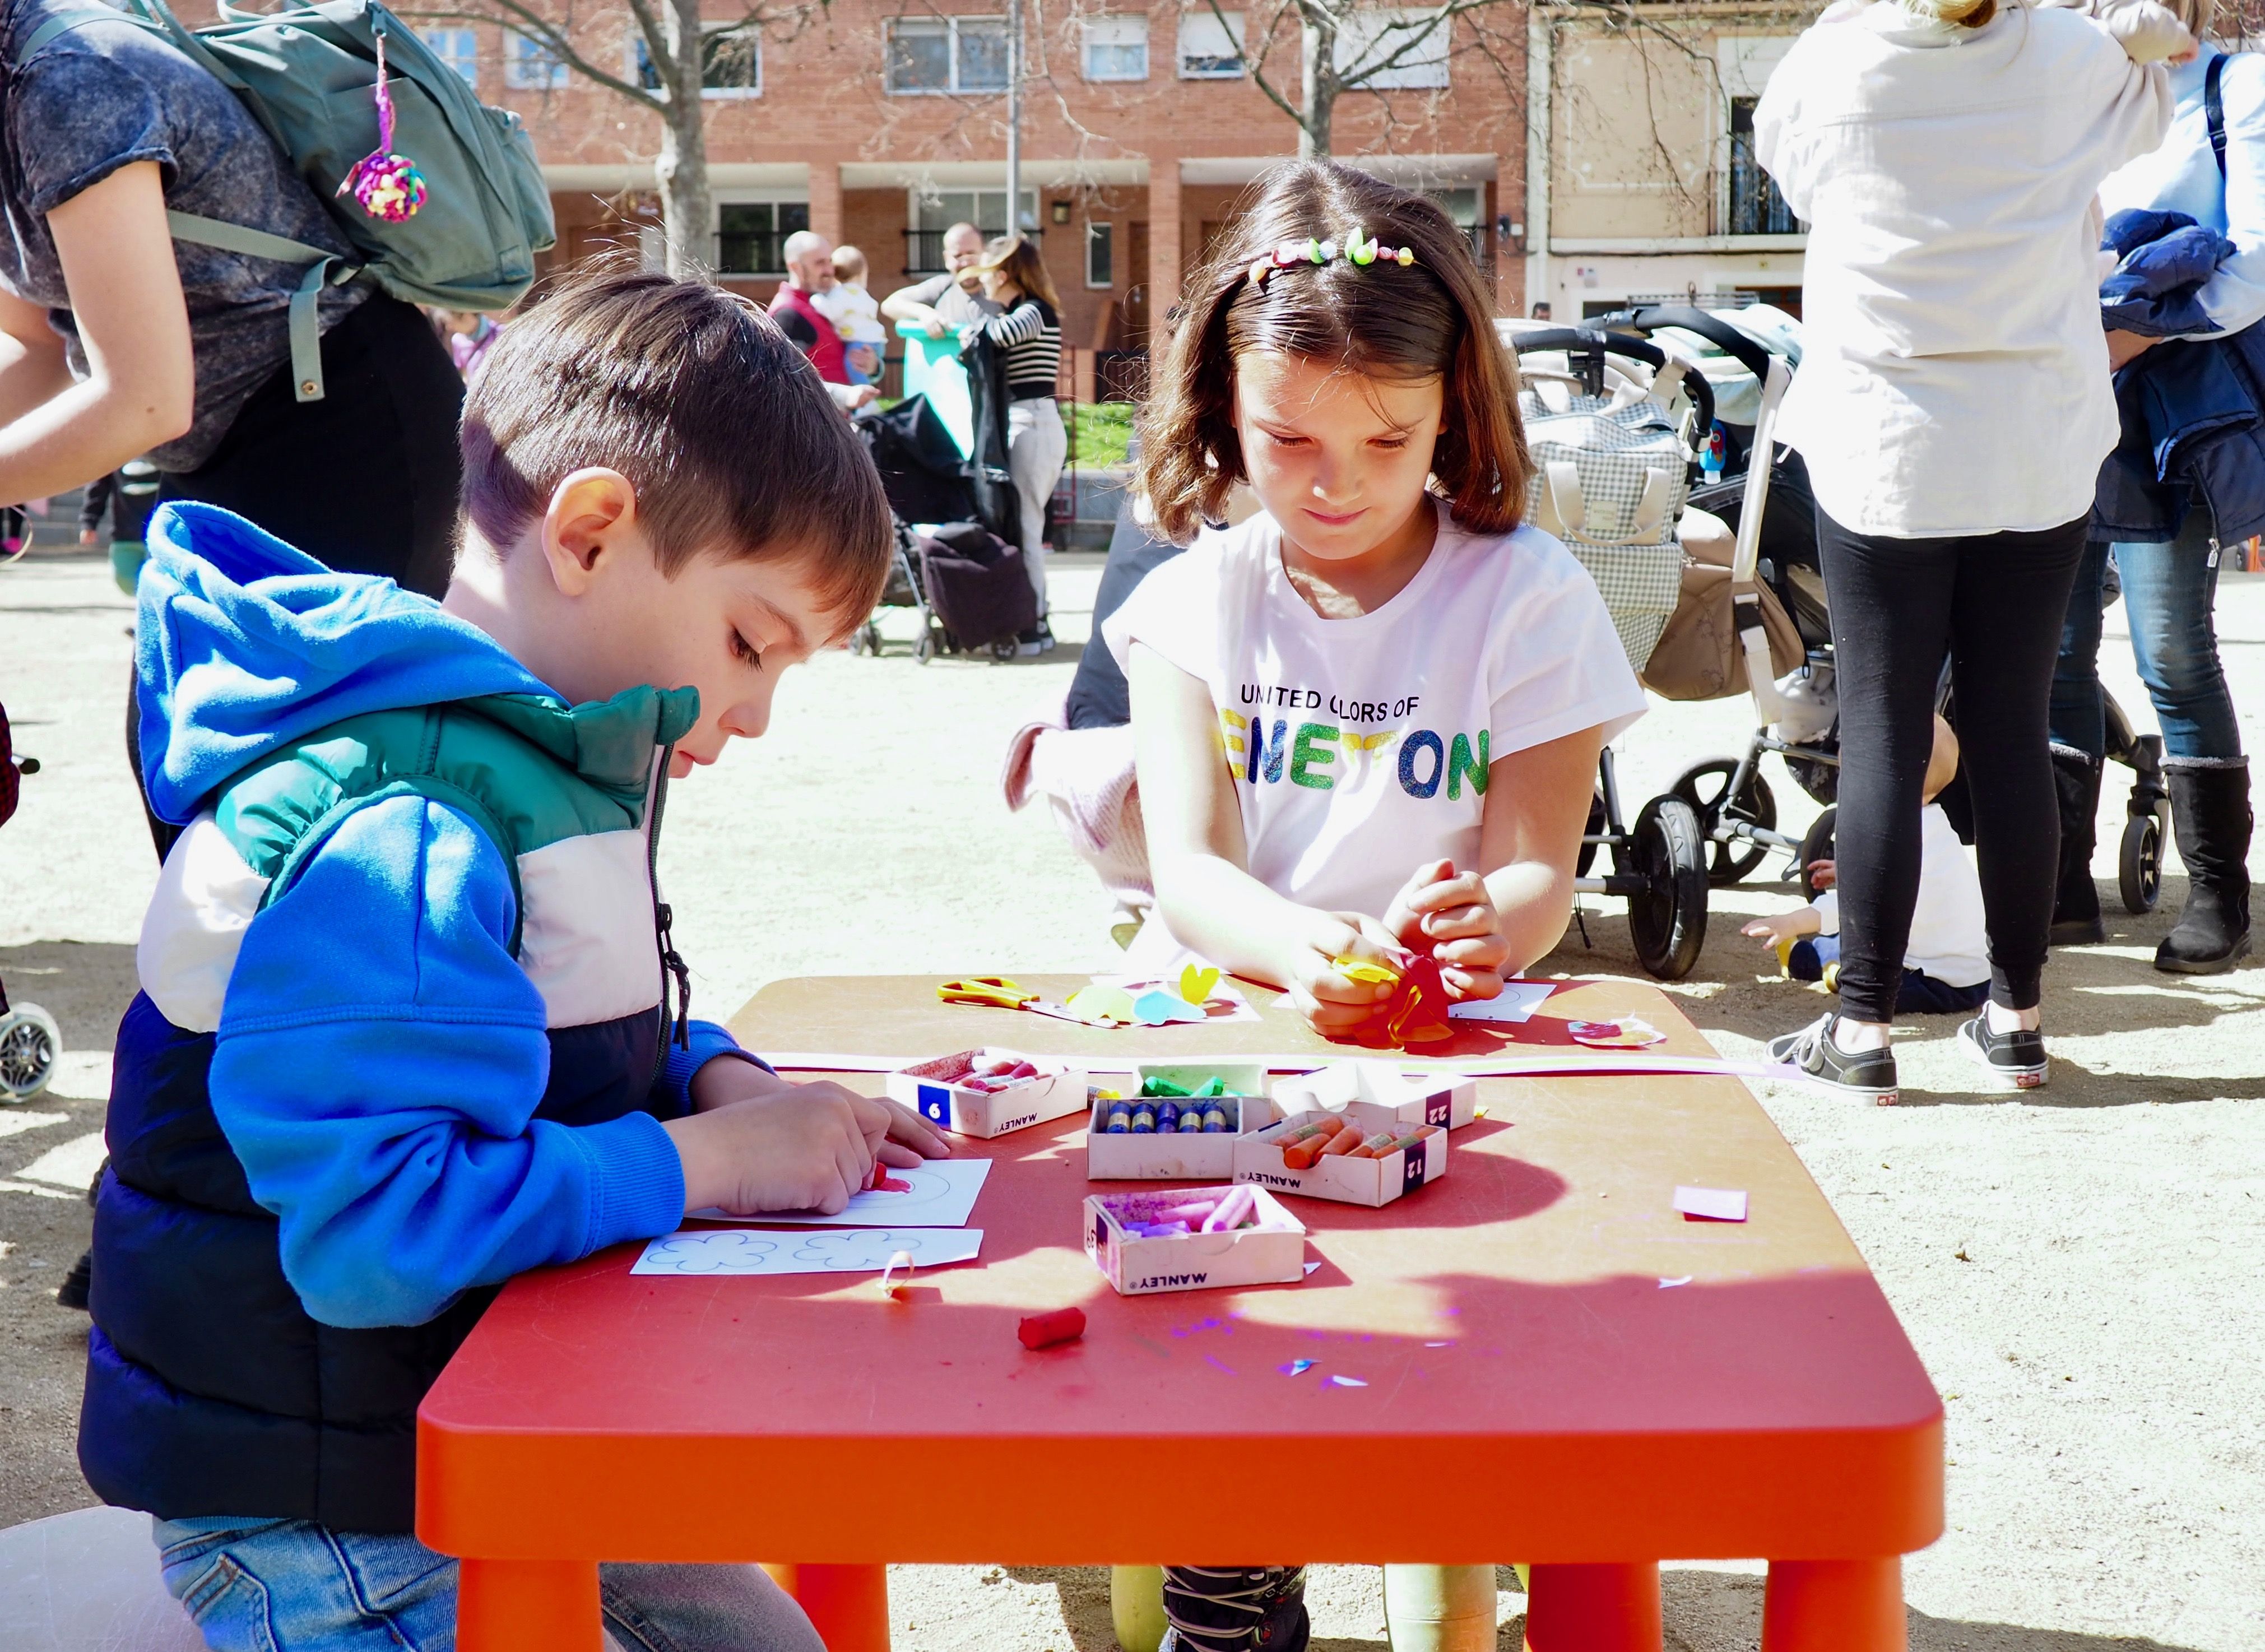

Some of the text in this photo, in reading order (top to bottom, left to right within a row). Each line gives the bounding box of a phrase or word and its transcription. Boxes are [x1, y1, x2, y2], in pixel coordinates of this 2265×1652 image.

[1241, 684, 1419, 722] UNITED CLORS OF
[1429, 1105, 1447, 1124] 22
[1408, 1159, 1422, 1178] 12
